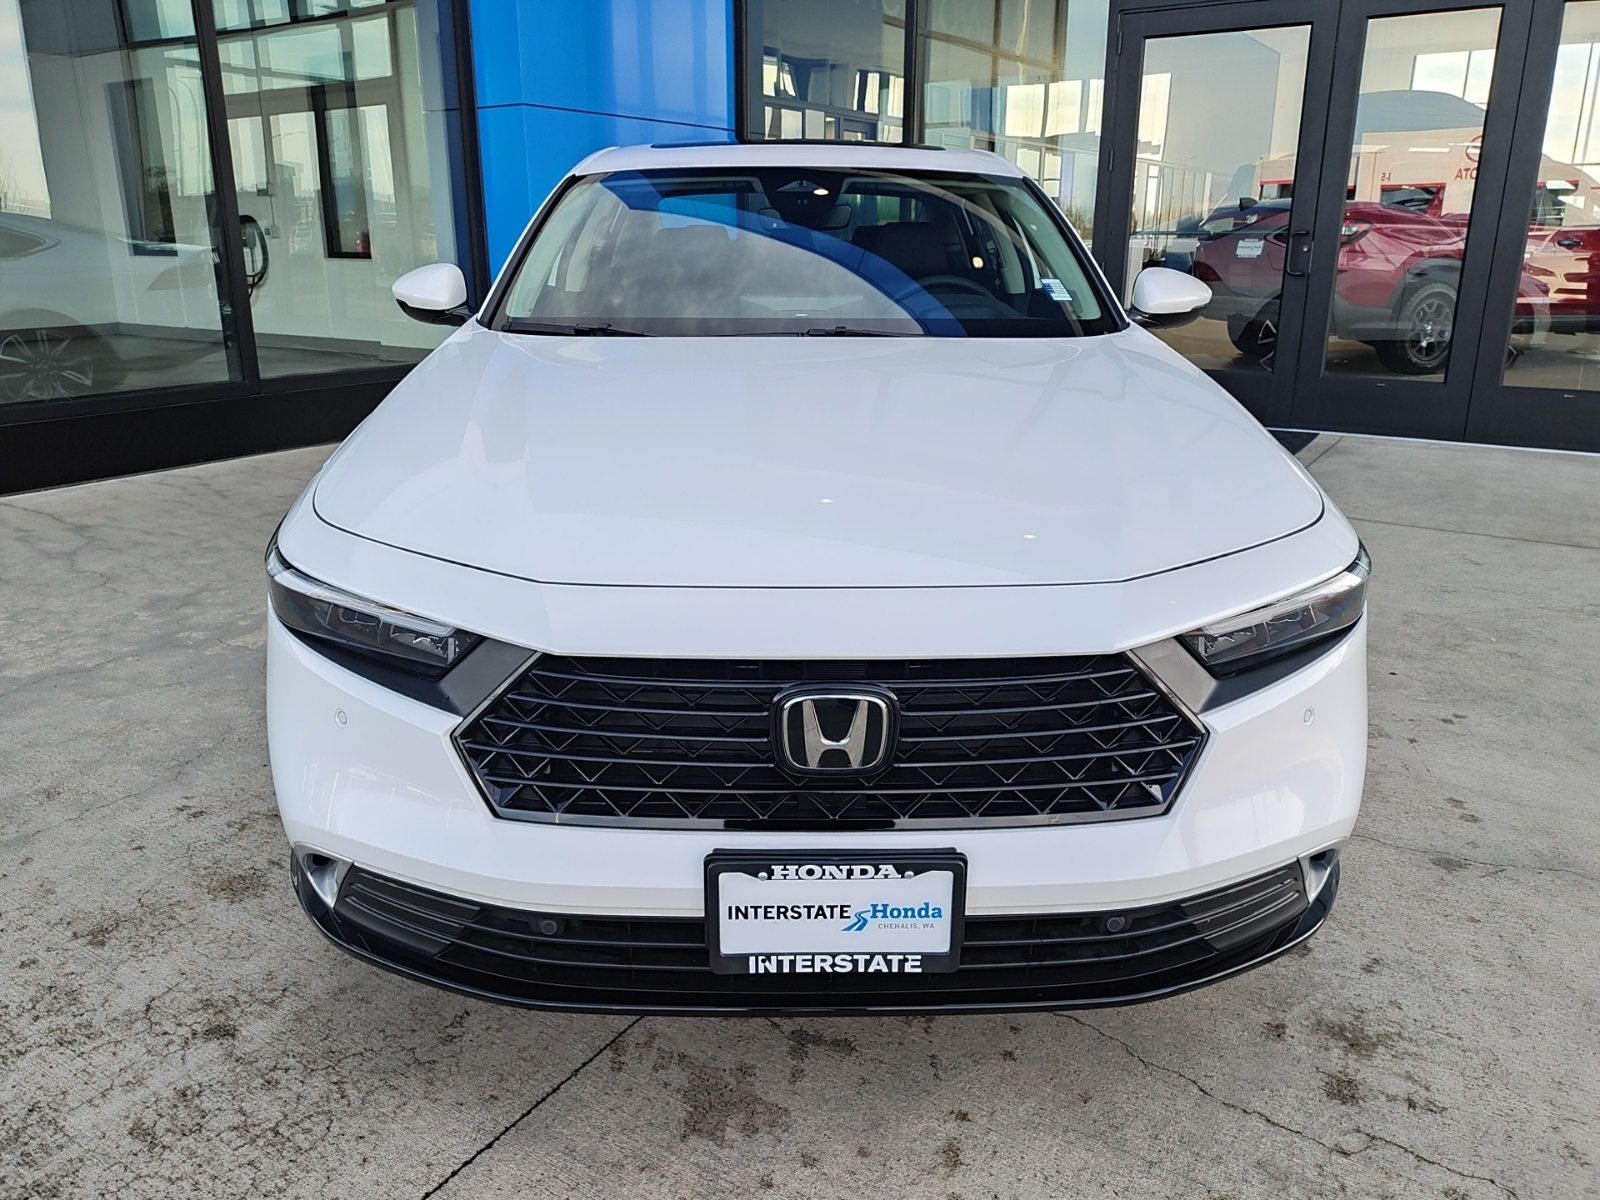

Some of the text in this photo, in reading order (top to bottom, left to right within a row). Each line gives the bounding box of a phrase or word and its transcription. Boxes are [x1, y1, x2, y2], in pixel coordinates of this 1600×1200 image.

[771, 864, 901, 880] HONDA
[728, 903, 943, 919] INTERSTATE Honda
[878, 922, 920, 930] CHEHALIS,
[749, 955, 922, 973] INTERSTATE
